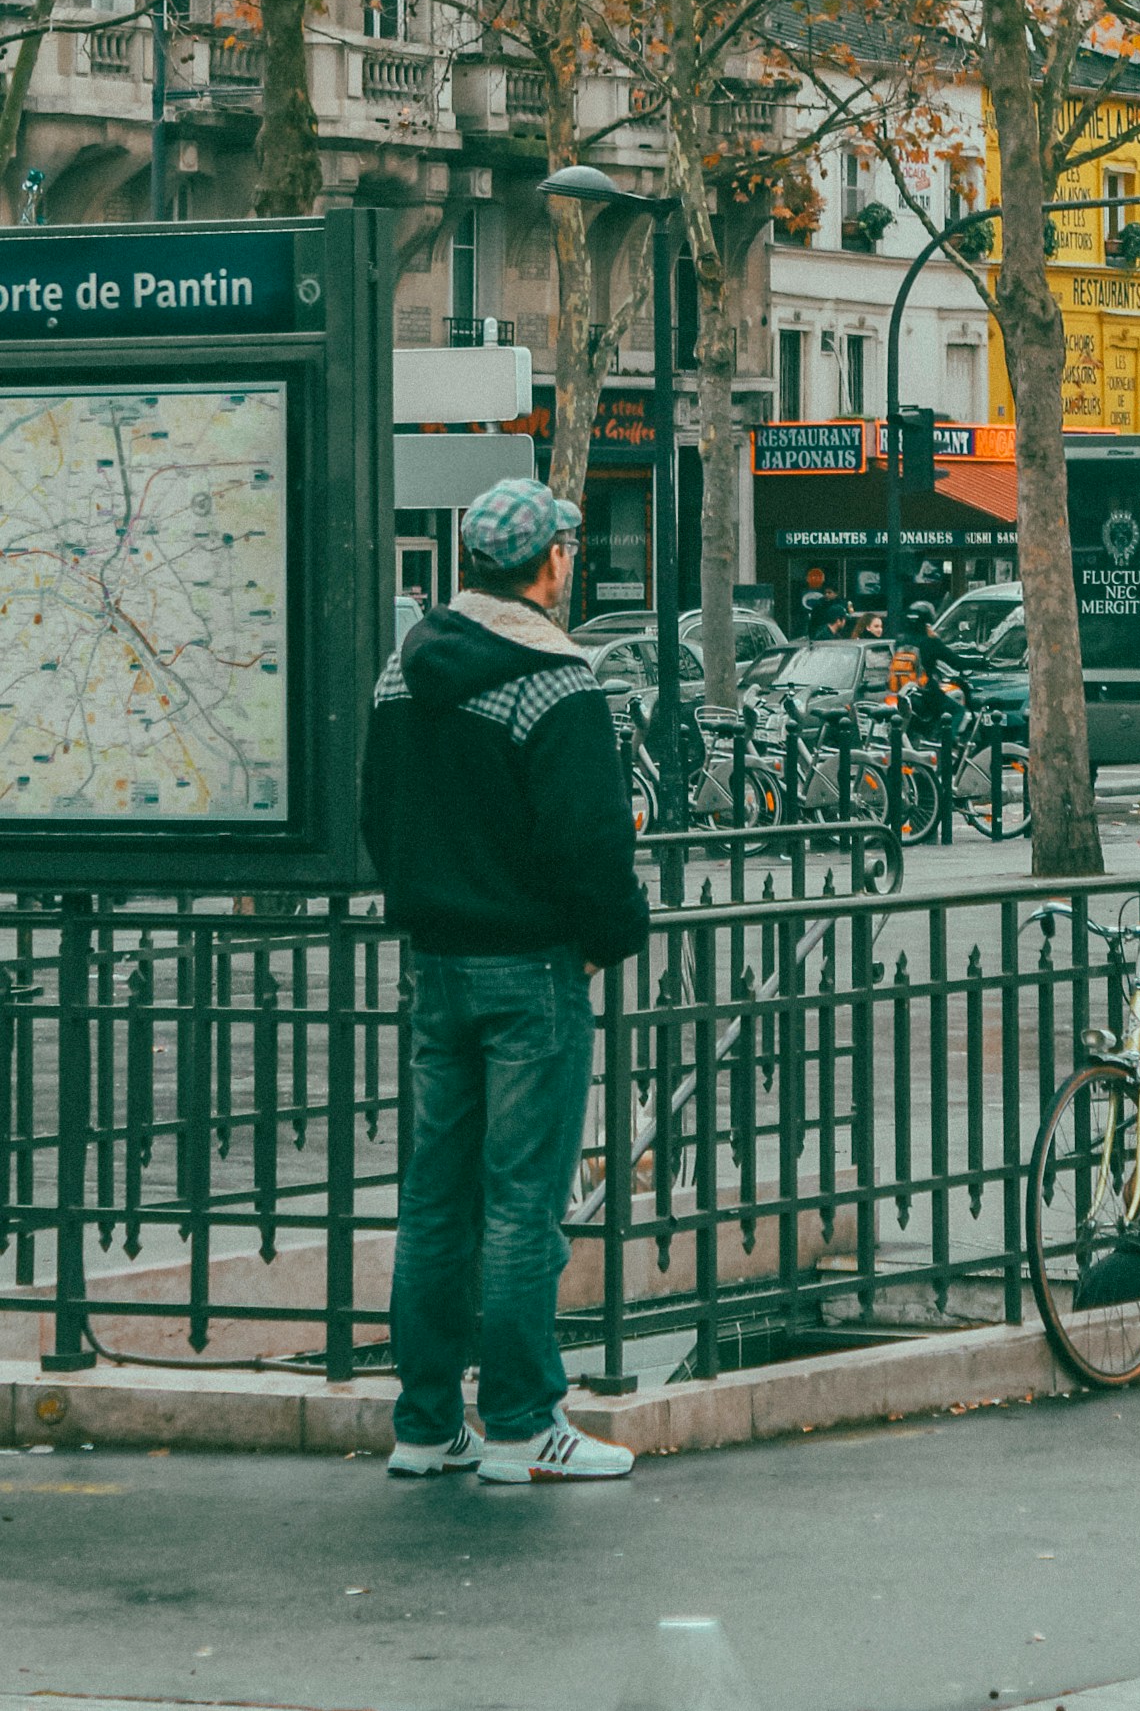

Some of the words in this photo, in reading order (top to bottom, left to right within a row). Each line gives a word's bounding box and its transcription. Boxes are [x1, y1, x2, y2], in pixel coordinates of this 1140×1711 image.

[0, 277, 63, 312] rte
[76, 273, 121, 310] de
[133, 268, 253, 308] Pantin
[757, 427, 862, 447] RESTAURANT
[761, 450, 857, 470] JAPONAIS
[785, 531, 867, 545] SPECIALITES
[874, 531, 954, 545] JAONAISES
[964, 531, 992, 545] SUSHI
[1105, 586, 1137, 600] NEC
